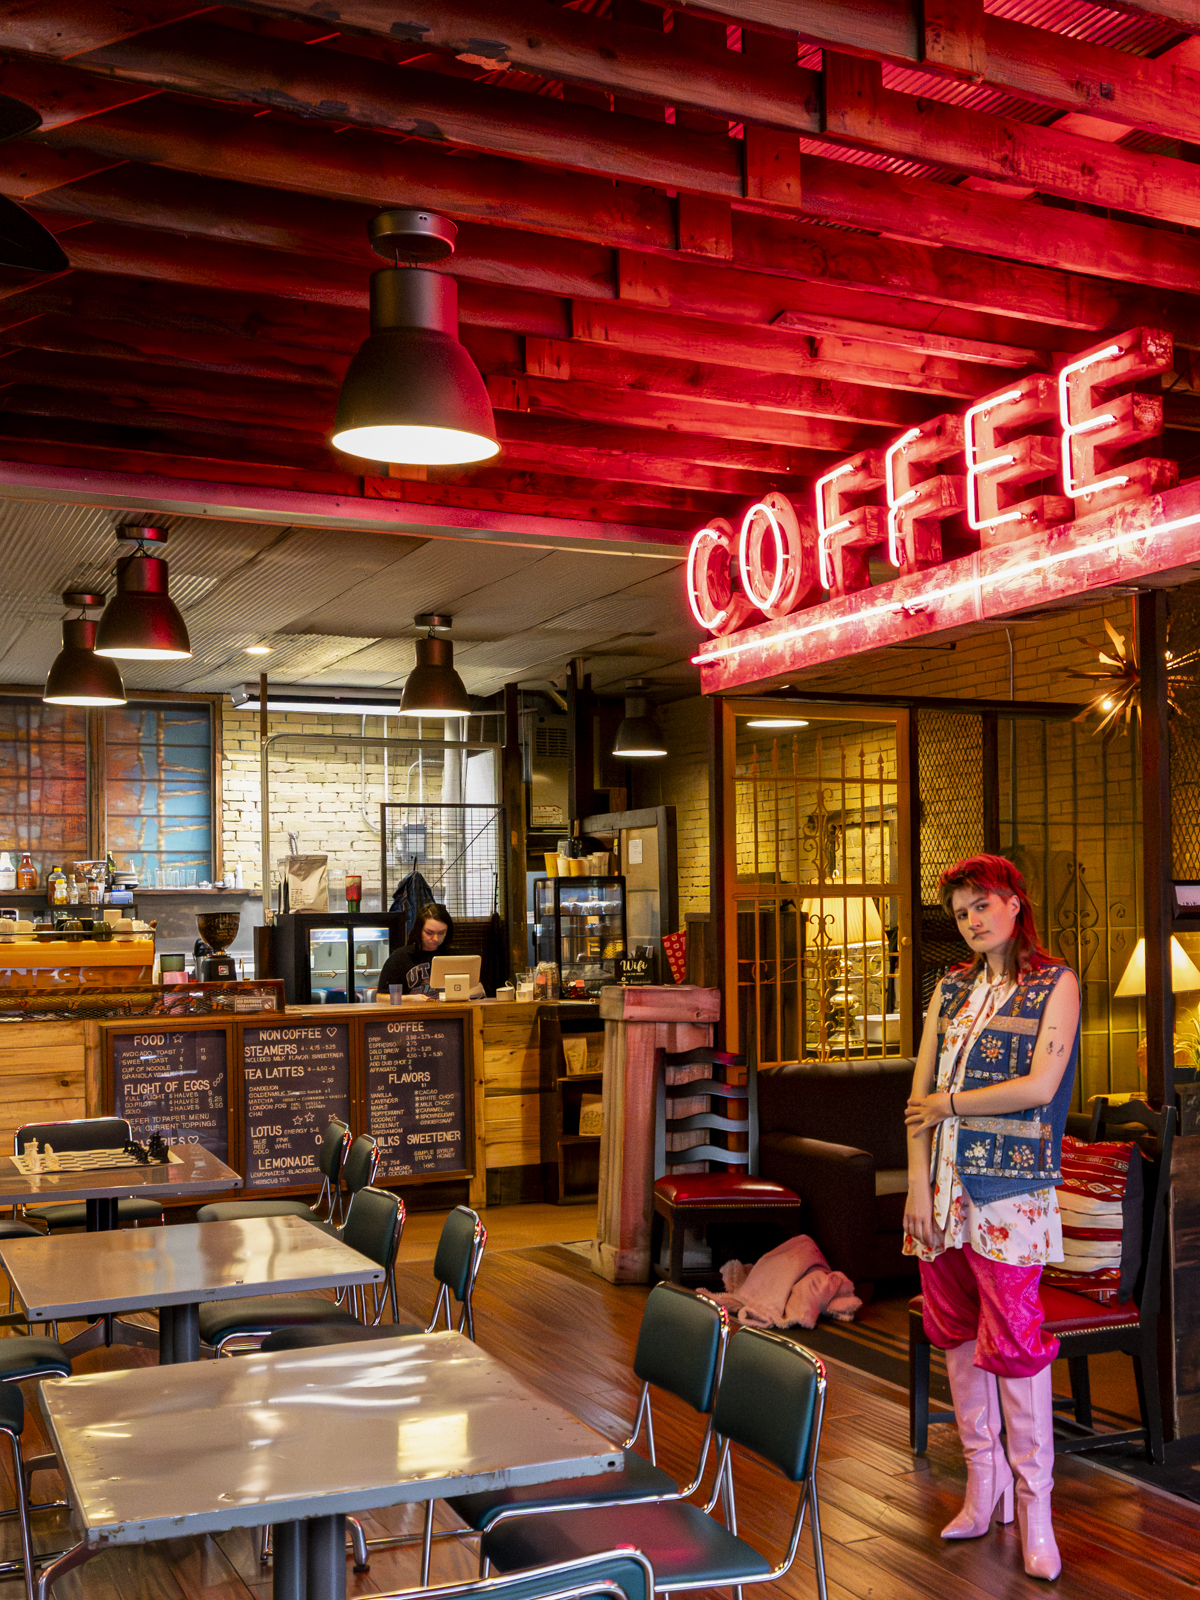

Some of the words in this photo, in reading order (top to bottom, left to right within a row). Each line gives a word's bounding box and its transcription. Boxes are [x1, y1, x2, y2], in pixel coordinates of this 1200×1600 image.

[687, 326, 1178, 636] COFFEE
[620, 960, 648, 972] Wifi
[387, 1022, 424, 1033] COFFEE
[134, 1034, 164, 1046] FOOD
[260, 1030, 280, 1040] NON
[282, 1028, 322, 1040] COFFEE
[244, 1044, 298, 1057] STEAMERS
[244, 1068, 262, 1080] TEA
[266, 1066, 305, 1078] LATTES
[389, 1072, 430, 1084] FLAVORS
[124, 1083, 161, 1095] FLIGHT
[165, 1082, 179, 1092] OF
[184, 1080, 210, 1092] EGGS
[145, 1123, 178, 1132] CURRENT
[182, 1120, 216, 1128] TOPPINGS
[251, 1125, 282, 1138] LOTUS
[407, 1131, 461, 1145] SWEETENER
[259, 1155, 315, 1170] LEMONADE
[250, 1170, 285, 1178] LEMONADES
